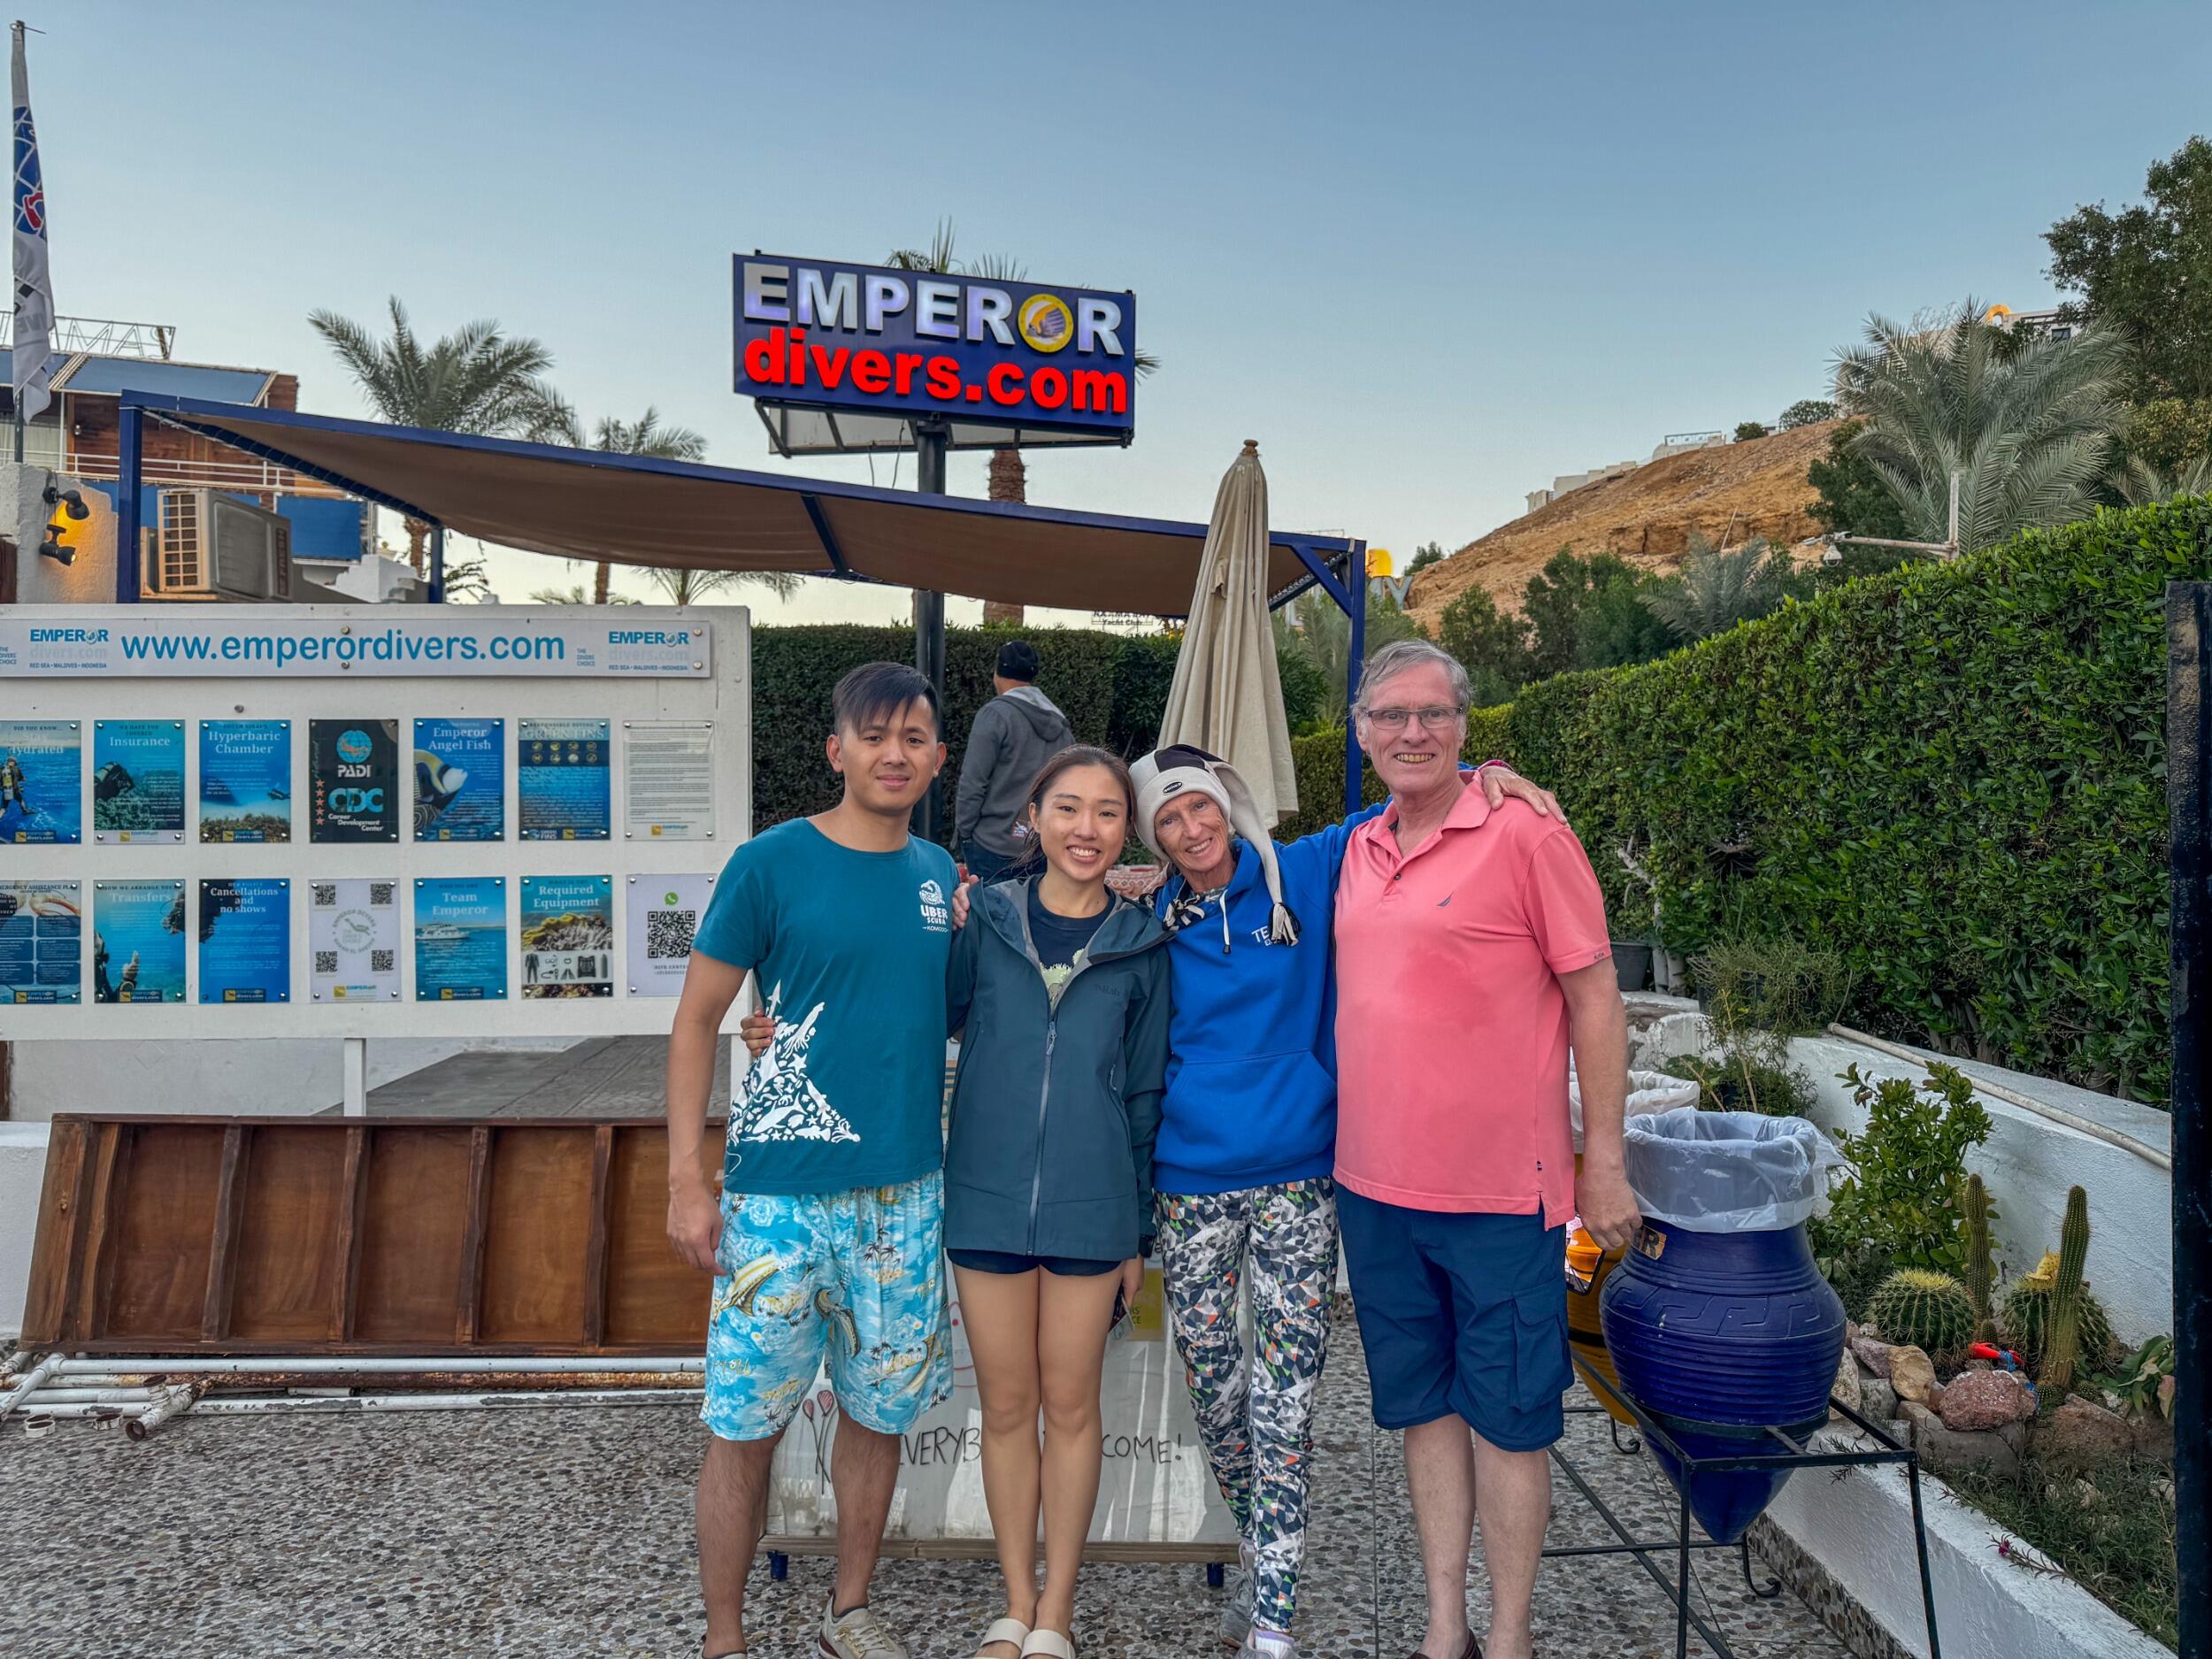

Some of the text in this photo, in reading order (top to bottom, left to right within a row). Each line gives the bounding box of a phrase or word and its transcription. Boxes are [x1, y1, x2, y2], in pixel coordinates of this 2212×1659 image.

[743, 262, 1125, 356] EMPEROR
[744, 327, 1127, 413] divers.com
[29, 629, 109, 644] EMPEROR
[608, 631, 689, 646] EMPEROR
[120, 629, 565, 667] www.emperordivers.com
[209, 731, 280, 743] Hyperbaric
[433, 727, 488, 740] Emperor
[110, 736, 171, 747] Insurance
[428, 740, 492, 752] Angel Fish
[215, 744, 273, 754] Chamber
[338, 764, 372, 778] PADI
[328, 787, 383, 813] CDC
[338, 819, 380, 829] Development
[111, 892, 172, 902] Transfers
[211, 887, 279, 896] Cancellations
[442, 892, 478, 902] Team
[539, 885, 594, 897] Required
[234, 904, 266, 913] shows
[534, 897, 599, 909] Equipment
[432, 905, 488, 918] Emperor
[920, 904, 948, 920] UBER
[926, 917, 946, 926] SCUBA
[899, 1426, 981, 1466] VERYB
